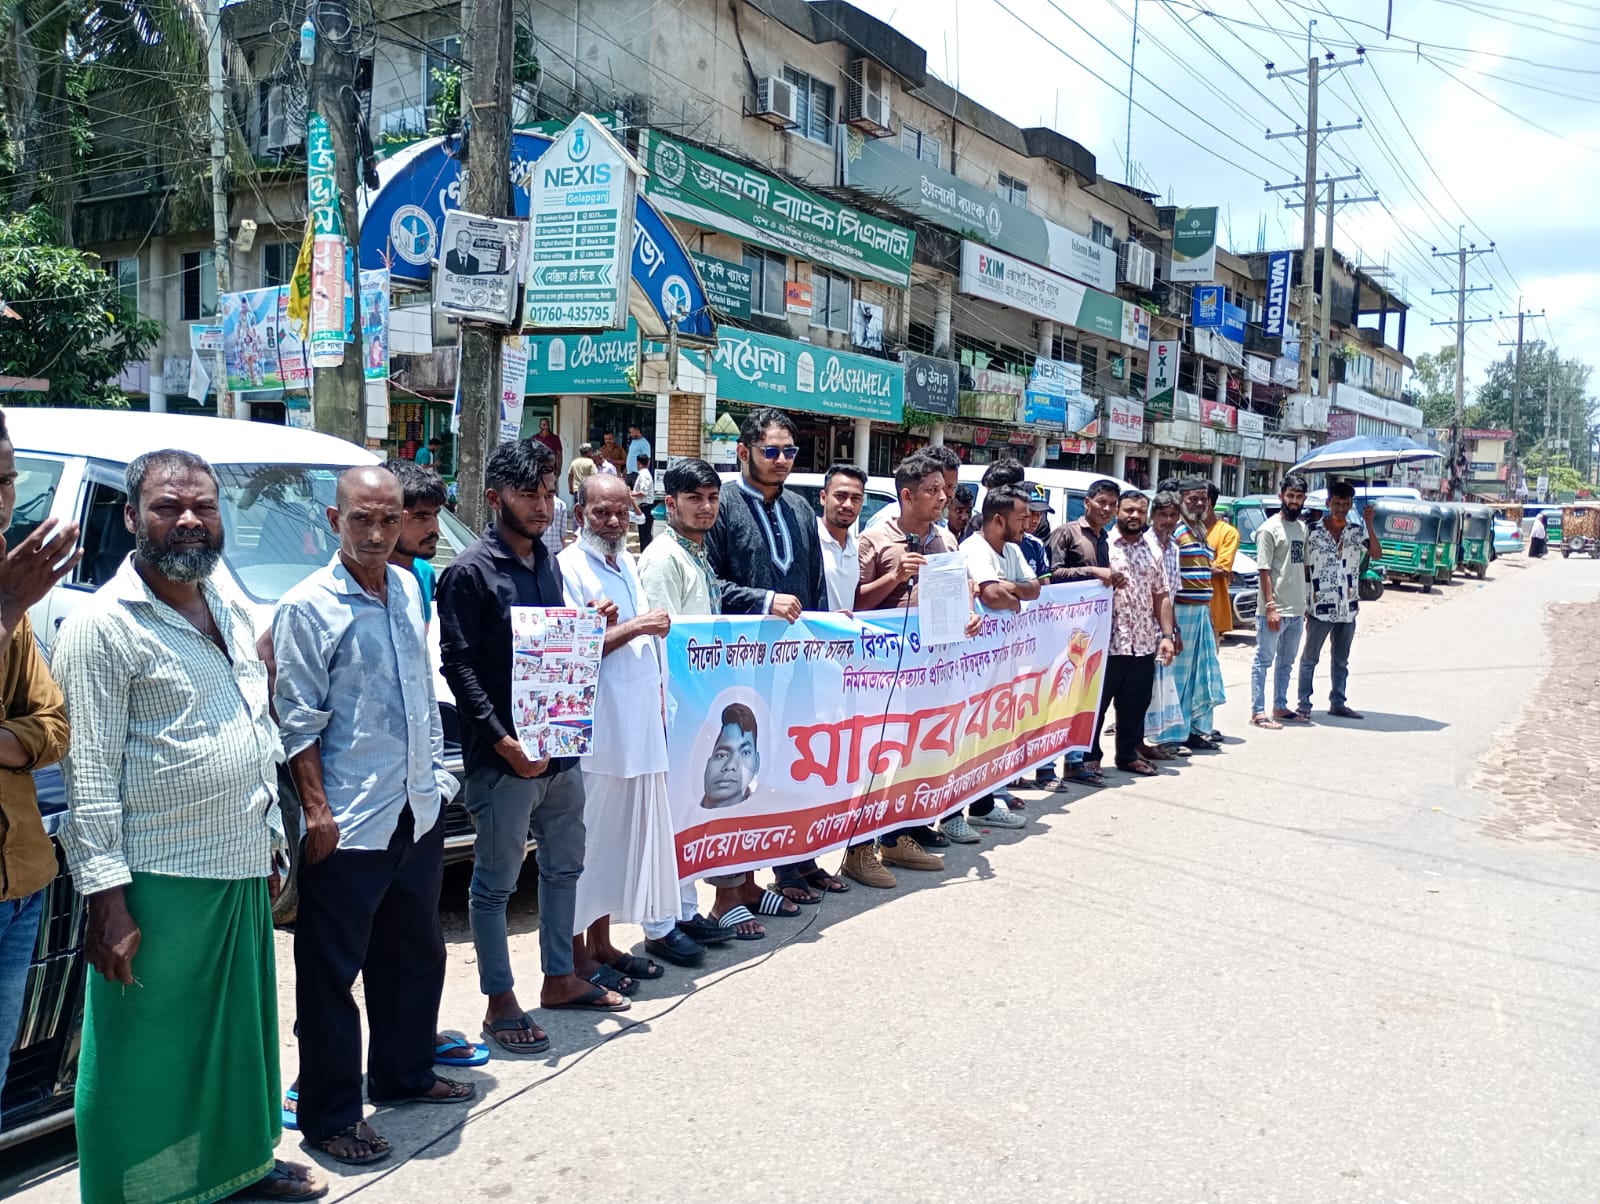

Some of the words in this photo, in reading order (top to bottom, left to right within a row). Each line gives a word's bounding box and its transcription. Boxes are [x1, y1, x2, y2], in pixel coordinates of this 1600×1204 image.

[544, 164, 611, 188] NEXIS
[691, 162, 769, 209] অগ্রণী
[567, 191, 609, 204] Golapganj
[920, 175, 956, 208] ইসলামী
[958, 195, 985, 220] ব্যাংক
[568, 269, 578, 281] এই
[580, 268, 597, 280] দিকে
[708, 262, 725, 280] কৃষি
[726, 266, 750, 285] ব্যাংক
[979, 254, 1005, 280] EXIM
[727, 297, 741, 307] Bank
[1266, 257, 1286, 334] WALTON
[530, 306, 609, 321] 01760-435795
[819, 356, 891, 397] RASHMELA
[1155, 345, 1168, 388] EXIM
[687, 635, 723, 672] সিলেট
[726, 635, 767, 667] জকিগঞ্জ
[769, 638, 801, 664] রোডে
[803, 638, 826, 662] বাস
[825, 638, 854, 660] চালক
[860, 626, 901, 660] রিপন
[908, 632, 921, 654] ও
[842, 664, 896, 695] নির্মমভাবে
[896, 667, 927, 690] হত্যার
[806, 799, 889, 845] গোলাপগঞ্জ
[894, 795, 907, 814] ও
